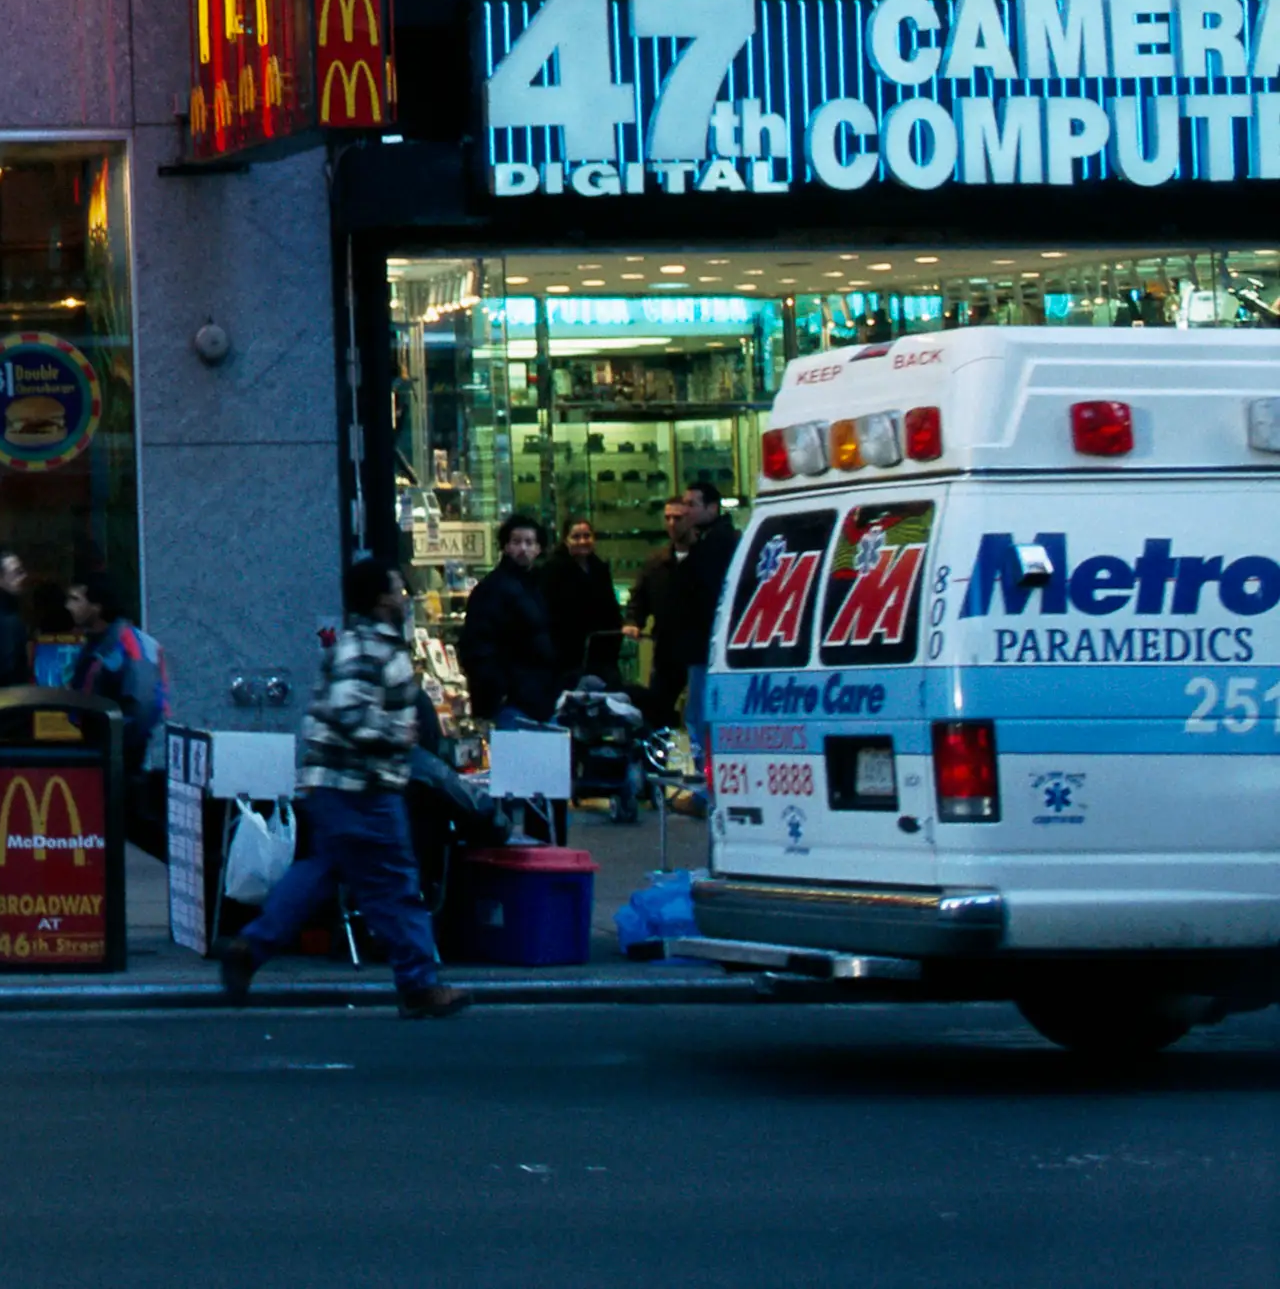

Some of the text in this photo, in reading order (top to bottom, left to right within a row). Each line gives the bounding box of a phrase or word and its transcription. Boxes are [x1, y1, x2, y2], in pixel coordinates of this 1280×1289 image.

[491, 159, 789, 197] DIGITAL
[14, 362, 61, 382] Double
[795, 348, 946, 386] KEEP BACK
[959, 532, 1280, 620] Metro
[994, 627, 1254, 664] PARAMEDICS
[741, 674, 821, 715] Metro
[821, 673, 887, 715] Care
[717, 722, 808, 751] PARAMEDICS
[7, 833, 106, 850] McDonald's
[37, 917, 63, 931] AT
[56, 936, 106, 957] Street
